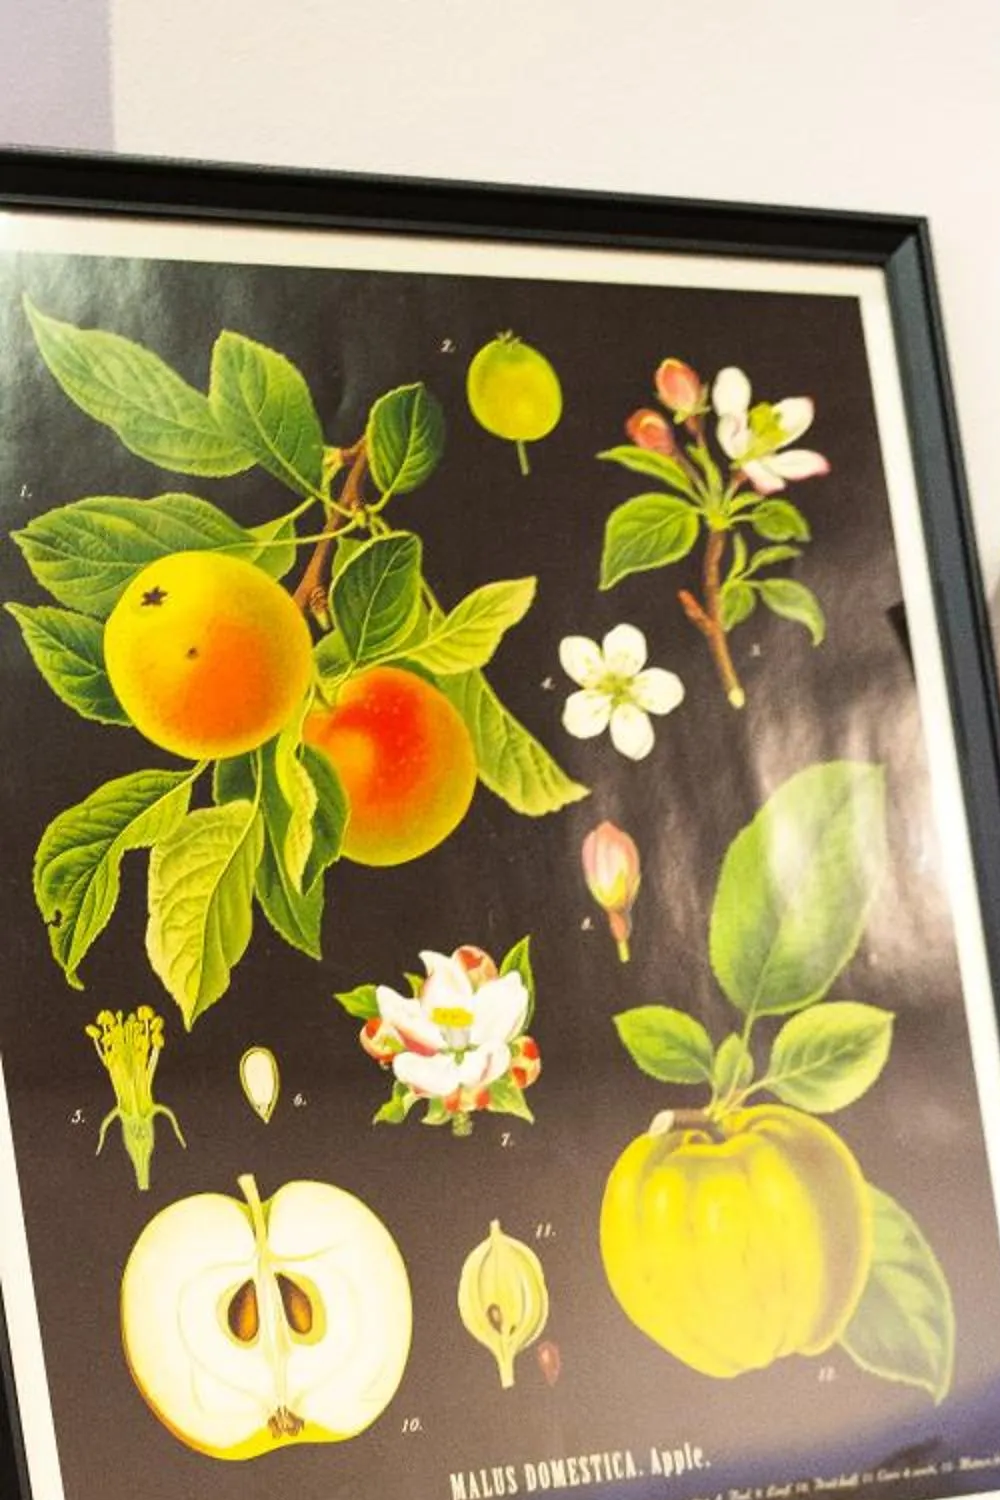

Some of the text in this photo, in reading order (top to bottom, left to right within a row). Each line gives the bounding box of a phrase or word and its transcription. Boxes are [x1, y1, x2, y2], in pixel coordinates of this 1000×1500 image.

[401, 1417, 423, 1432] 10.
[523, 1450, 644, 1492] DOMESTICA.
[651, 1443, 711, 1478] Apple.
